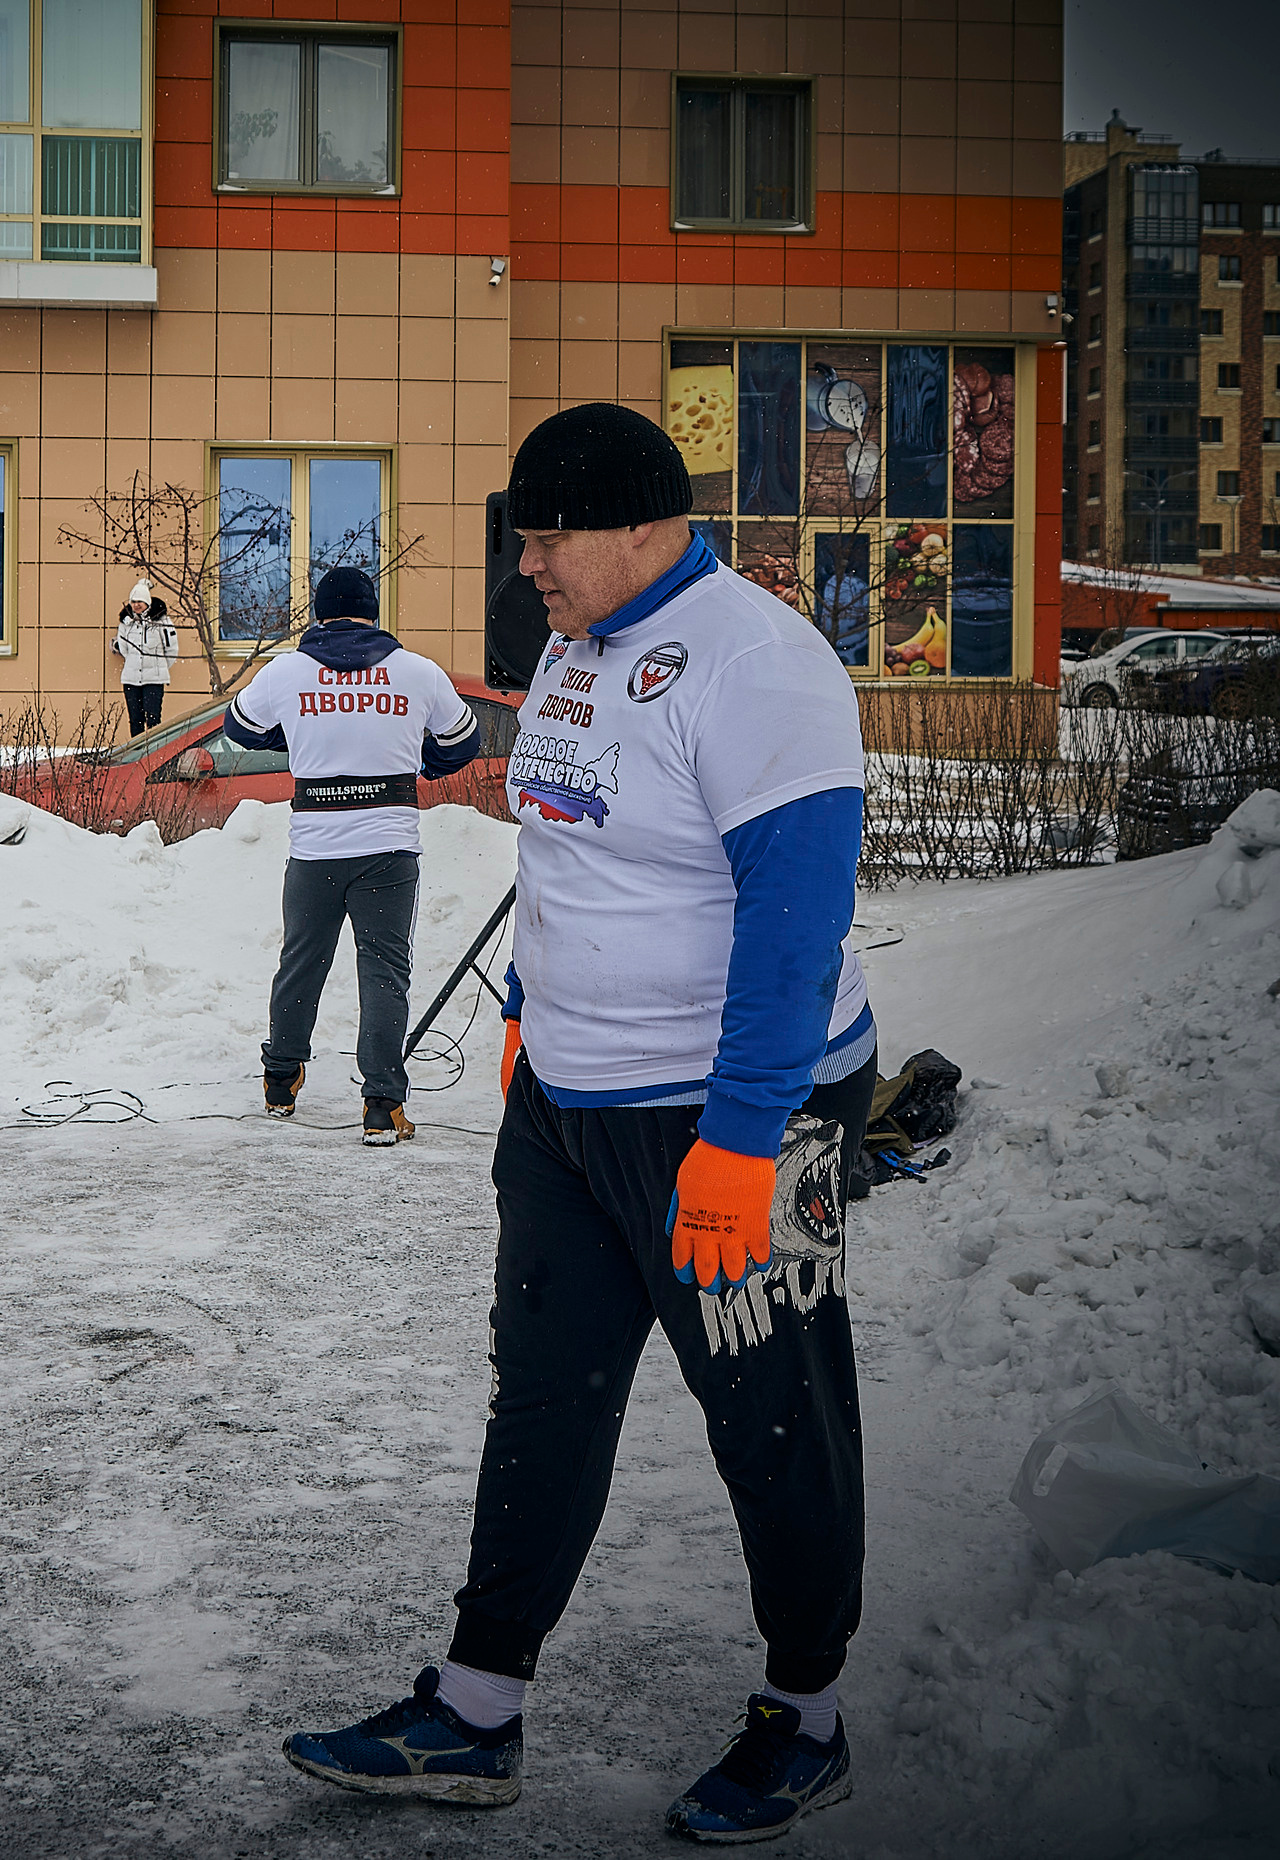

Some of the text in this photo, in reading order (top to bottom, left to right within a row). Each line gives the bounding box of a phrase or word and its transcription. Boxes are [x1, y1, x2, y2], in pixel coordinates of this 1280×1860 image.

[318, 667, 391, 686] СИЛА
[298, 692, 409, 717] ДВОРОВ
[537, 693, 595, 728] ДВОРОВ
[512, 755, 598, 794] ОТЕЧЕСТВО
[306, 784, 381, 797] ONHILLSPORT
